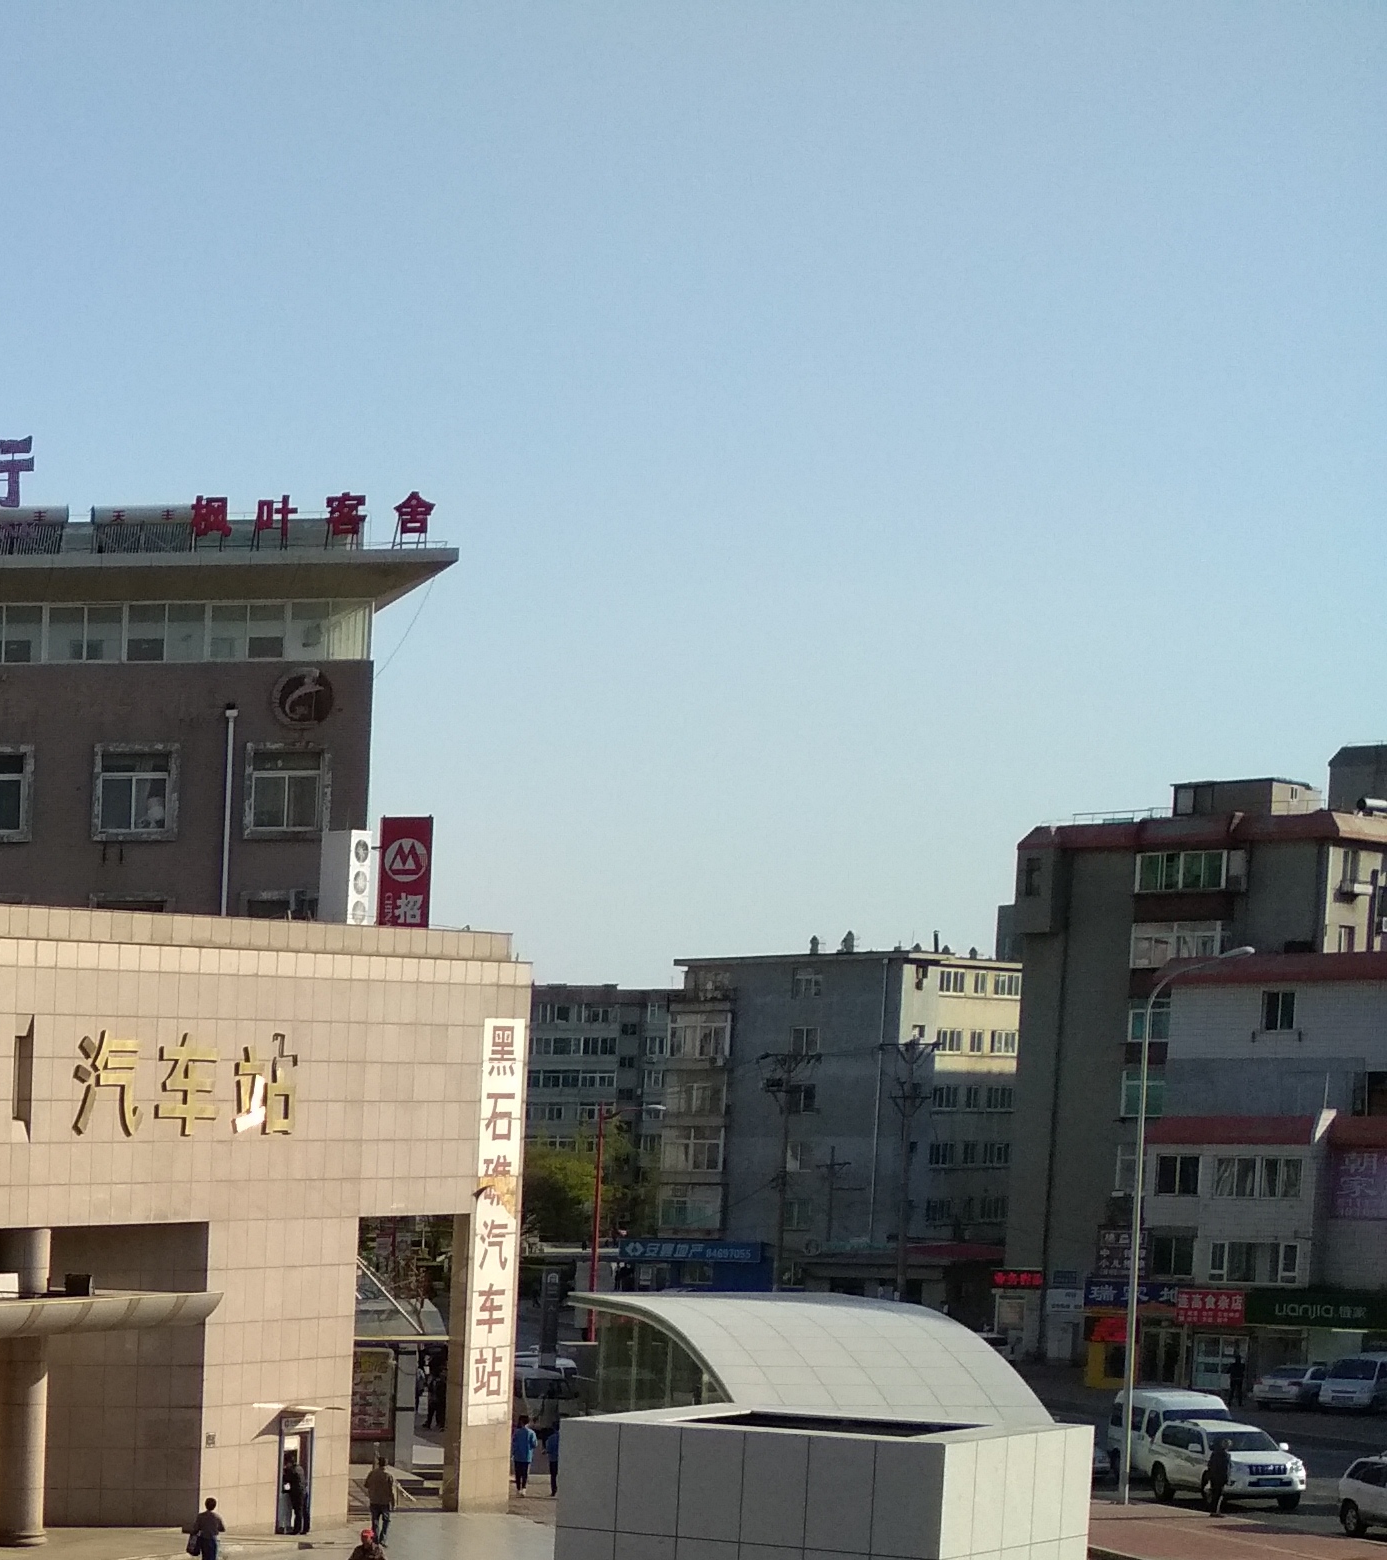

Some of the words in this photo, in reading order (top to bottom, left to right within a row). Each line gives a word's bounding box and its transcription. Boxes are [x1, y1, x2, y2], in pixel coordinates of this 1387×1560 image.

[192, 491, 435, 537] 枫叶客舍
[385, 893, 393, 926] CHIN
[394, 892, 424, 924] 招
[72, 1029, 299, 1138] 汽车站
[474, 1025, 517, 1397] 黑石礁汽车站
